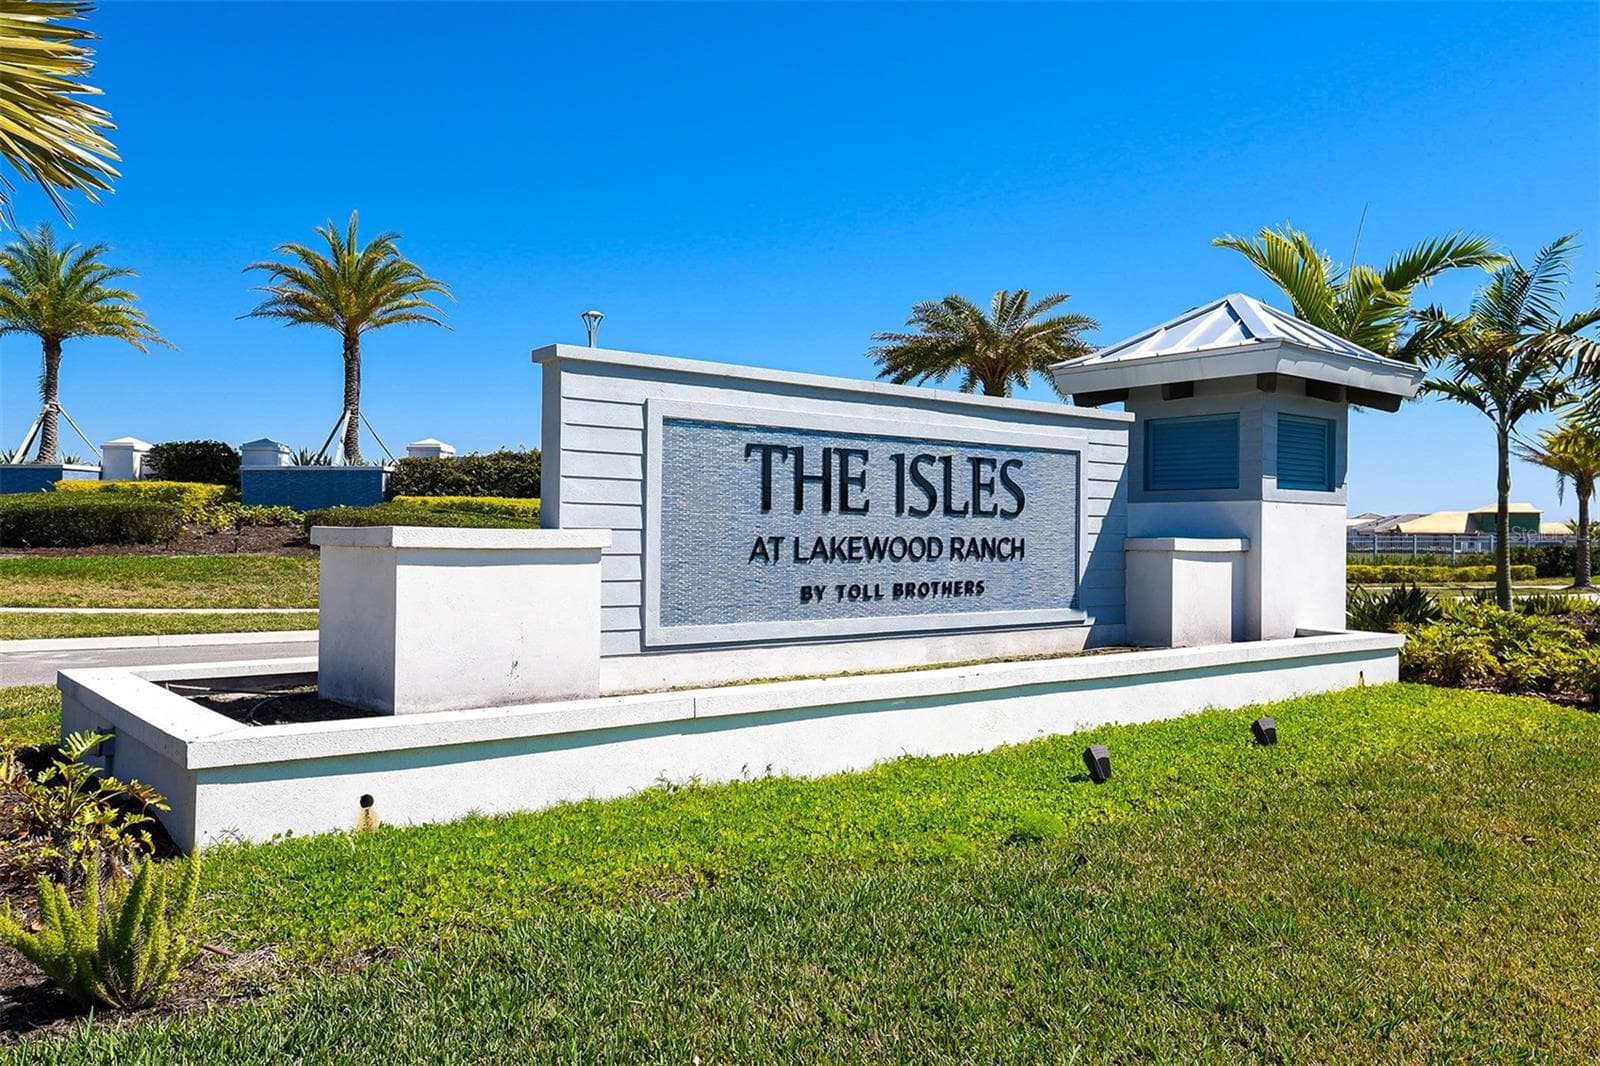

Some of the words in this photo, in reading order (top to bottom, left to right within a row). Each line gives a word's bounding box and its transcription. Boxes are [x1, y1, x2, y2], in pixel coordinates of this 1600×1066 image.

[745, 442, 869, 515] THE
[888, 453, 1025, 519] ISLES
[750, 536, 785, 565] AT
[794, 536, 942, 564] LAKEWOOD
[949, 536, 1024, 562] RANCH
[800, 585, 827, 603] BY
[836, 583, 884, 602] TOLL
[892, 581, 985, 601] BROTHERS
